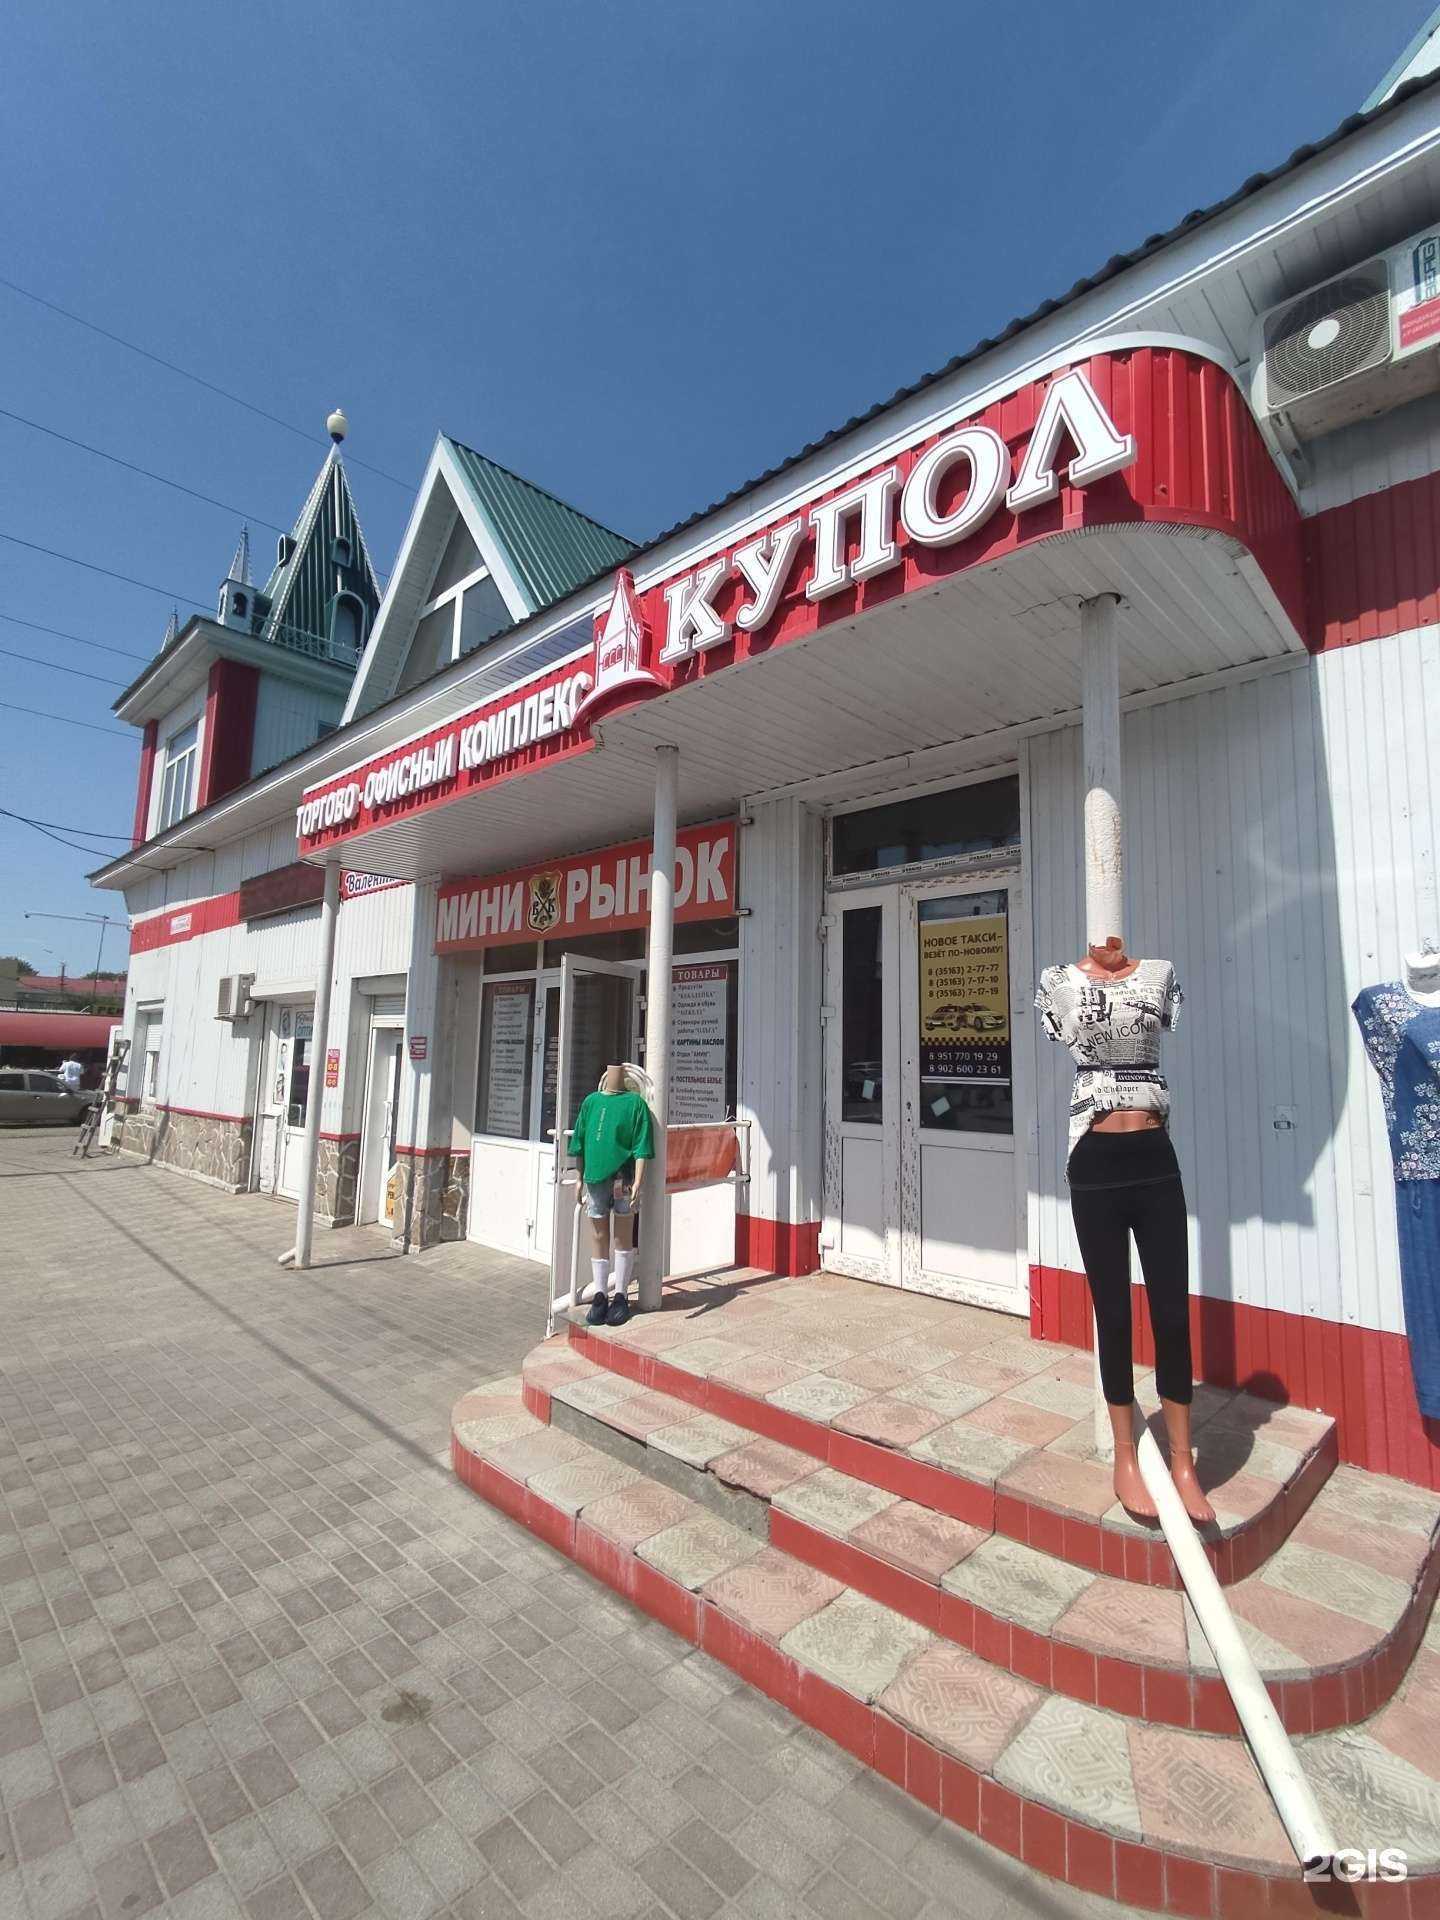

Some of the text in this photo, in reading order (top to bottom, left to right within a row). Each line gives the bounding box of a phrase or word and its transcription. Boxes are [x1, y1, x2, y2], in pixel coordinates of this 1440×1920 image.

[660, 368, 1137, 665] КУПОЛ
[458, 671, 593, 771] КОМПЛЕКС
[437, 837, 728, 942] МИНИ РЫНОК
[924, 936, 958, 948] НОВОЕ
[948, 945, 1003, 957] ПО-НОВОМУ!
[678, 969, 720, 980] ТОВАРЫ
[928, 963, 999, 977] 8 (35163) 2-77-77
[929, 979, 934, 987] 8
[936, 977, 965, 988] (35163)
[928, 990, 934, 998] 8
[936, 989, 965, 999] (35163)
[677, 1038, 725, 1046] КАРТИНЫ МАСЛОМ
[1086, 1029, 1113, 1050] NEW
[929, 1052, 998, 1061] 8 951 770 19 29
[929, 1064, 1001, 1074] 8 902 600 23 61
[676, 1076, 706, 1084] ПОСТЕЛЬНОЕ
